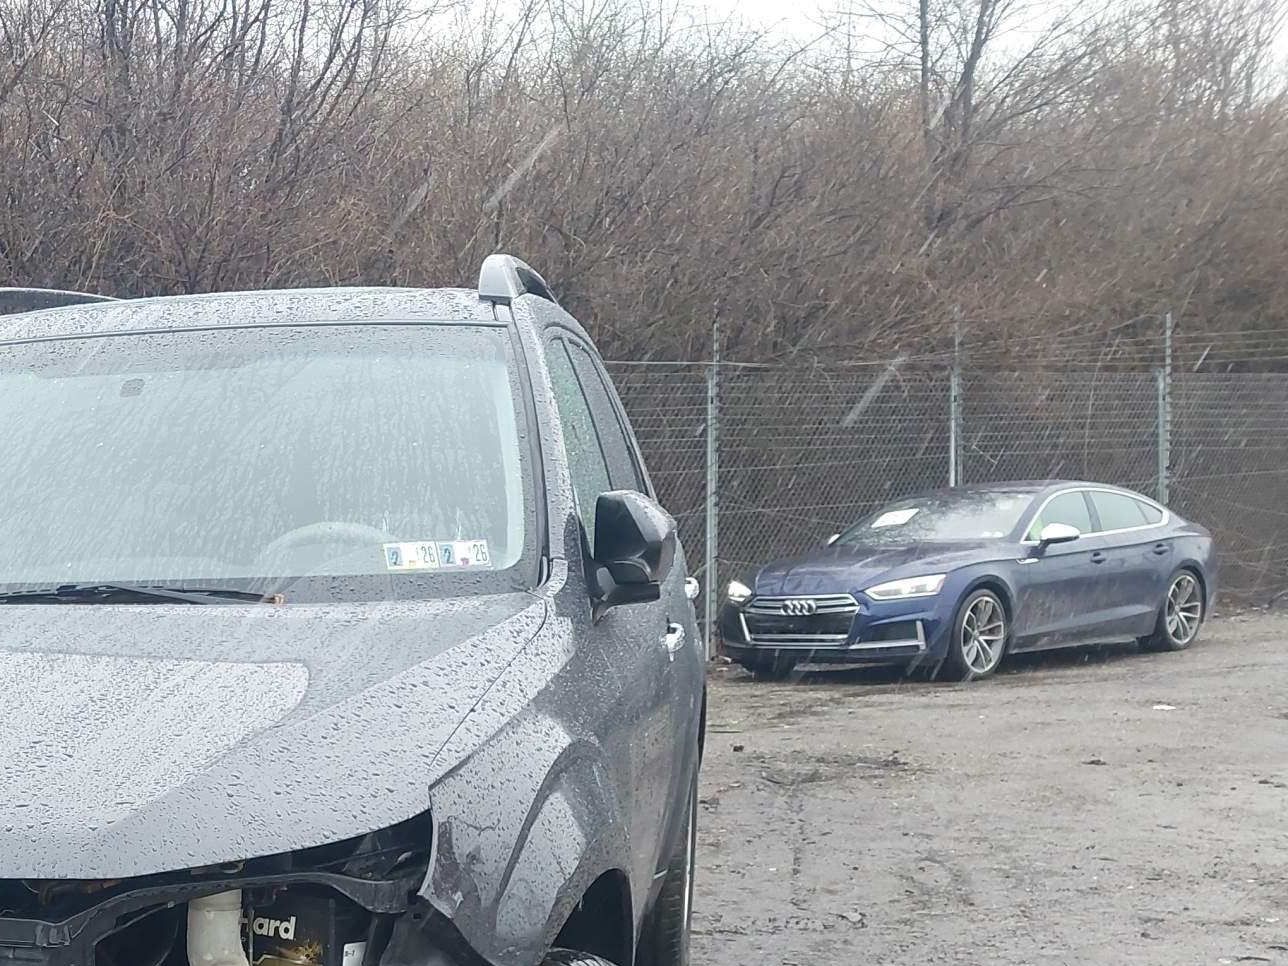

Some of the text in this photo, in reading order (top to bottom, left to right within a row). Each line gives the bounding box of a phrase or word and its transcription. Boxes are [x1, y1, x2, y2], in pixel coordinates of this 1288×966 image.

[391, 545, 436, 566] 2 26
[443, 543, 488, 565] 2 26
